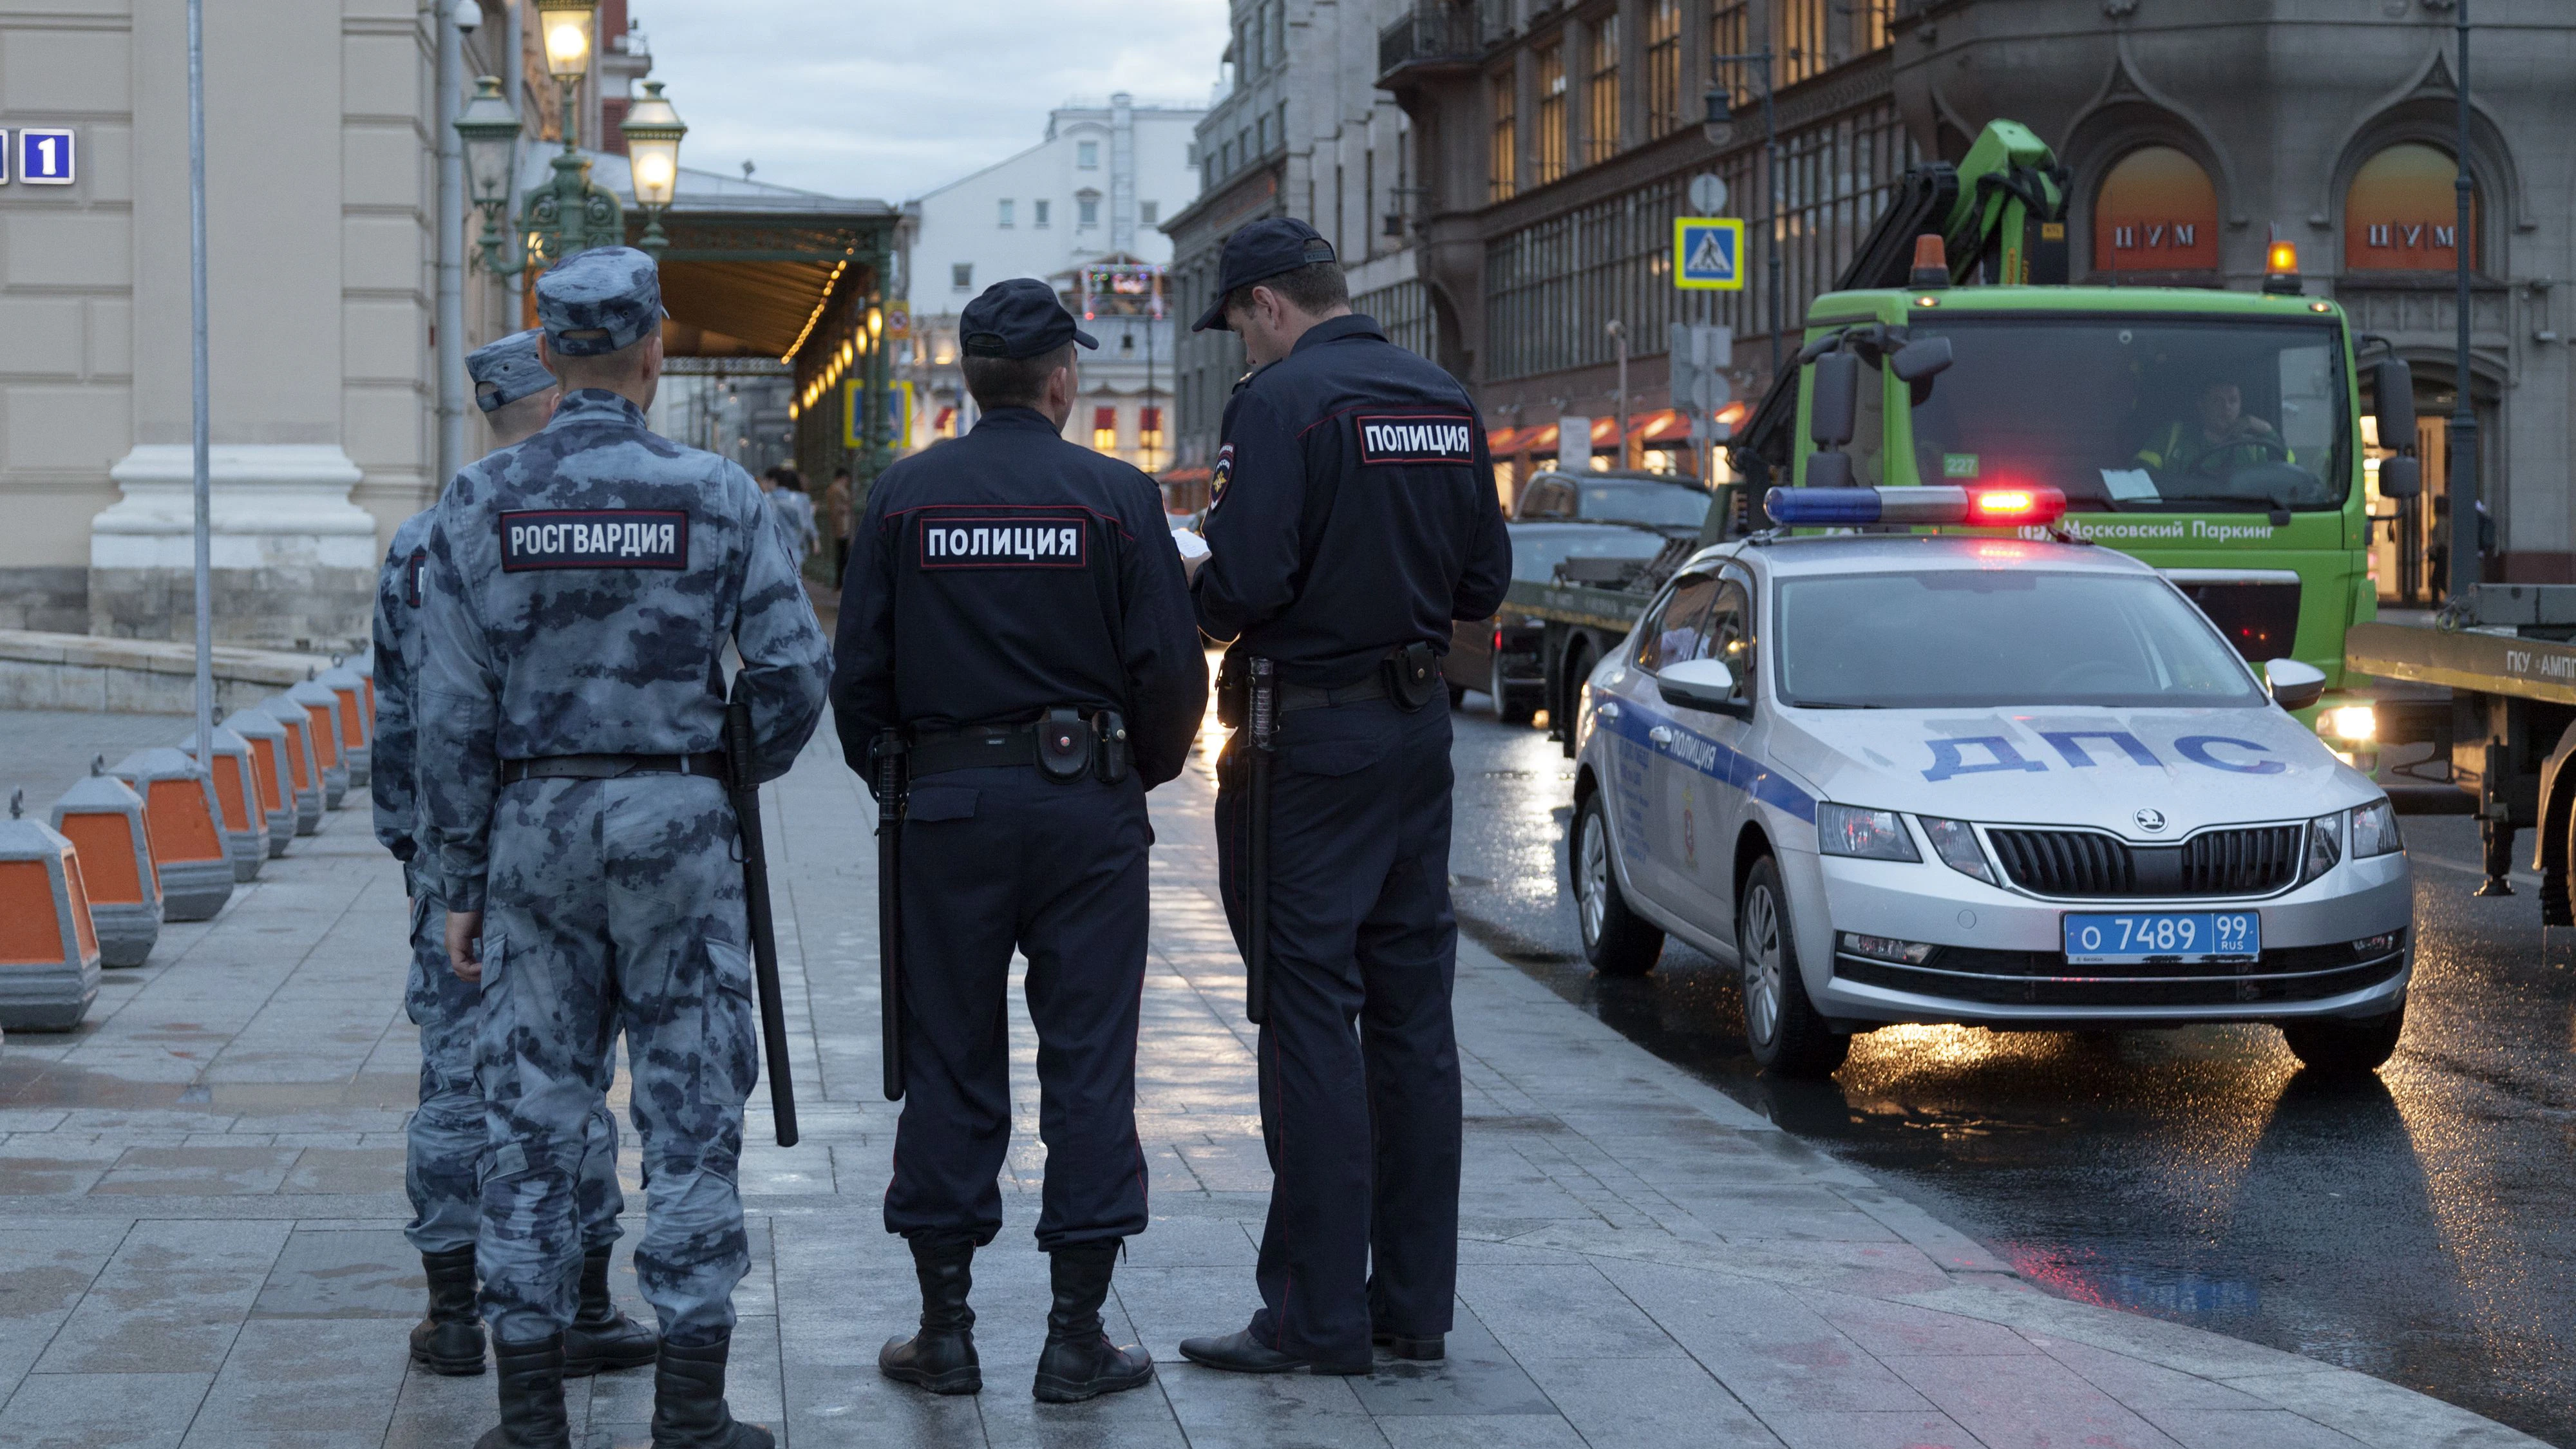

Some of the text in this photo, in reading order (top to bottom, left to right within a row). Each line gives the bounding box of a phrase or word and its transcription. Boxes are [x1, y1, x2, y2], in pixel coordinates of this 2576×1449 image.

[38, 137, 57, 175] 1
[1365, 425, 1470, 455] ПОЛИЦИЯ
[1947, 458, 1975, 474] 227
[511, 523, 675, 557] РОСГВАРДИЯ
[929, 528, 1077, 560] ПОЛИЦИЯ
[2063, 519, 2275, 543] Московский Паркинг
[2507, 650, 2531, 673] ГКУ
[1671, 730, 1718, 771] ПОЛИЦИЯ
[1920, 731, 2287, 782] ДПС
[2115, 918, 2196, 951] 7489
[2217, 916, 2247, 940] 99
[2222, 941, 2244, 951] RUS
